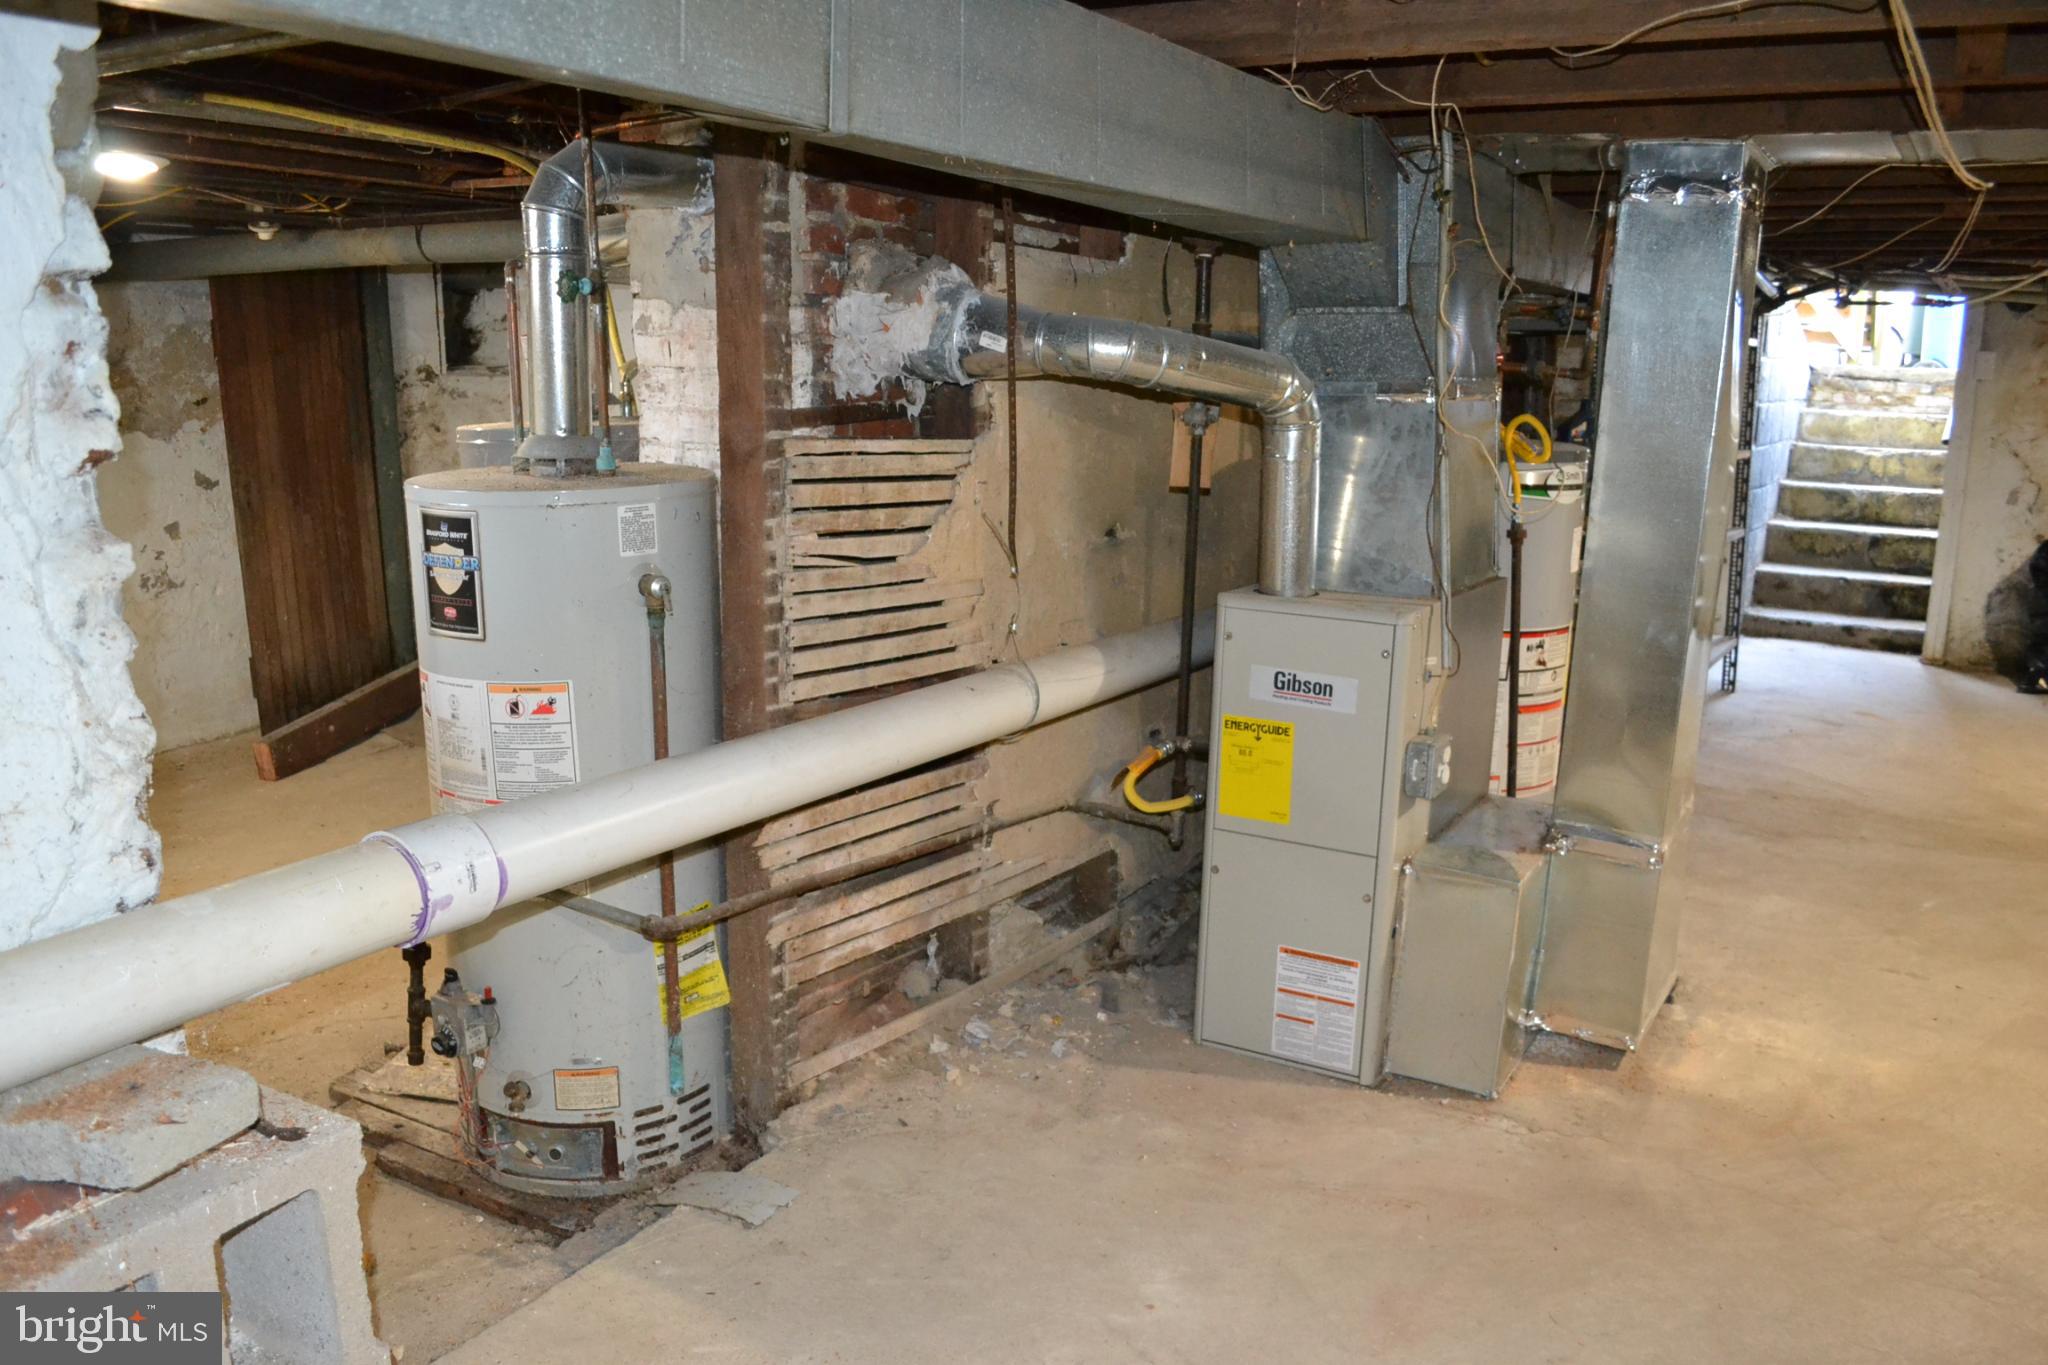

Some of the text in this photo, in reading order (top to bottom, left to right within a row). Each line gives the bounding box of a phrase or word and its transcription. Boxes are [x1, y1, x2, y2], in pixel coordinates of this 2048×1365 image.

[423, 552, 480, 571] DEFENDER
[1273, 671, 1333, 697] Gibson
[1224, 720, 1290, 737] ENERGYGUIDE
